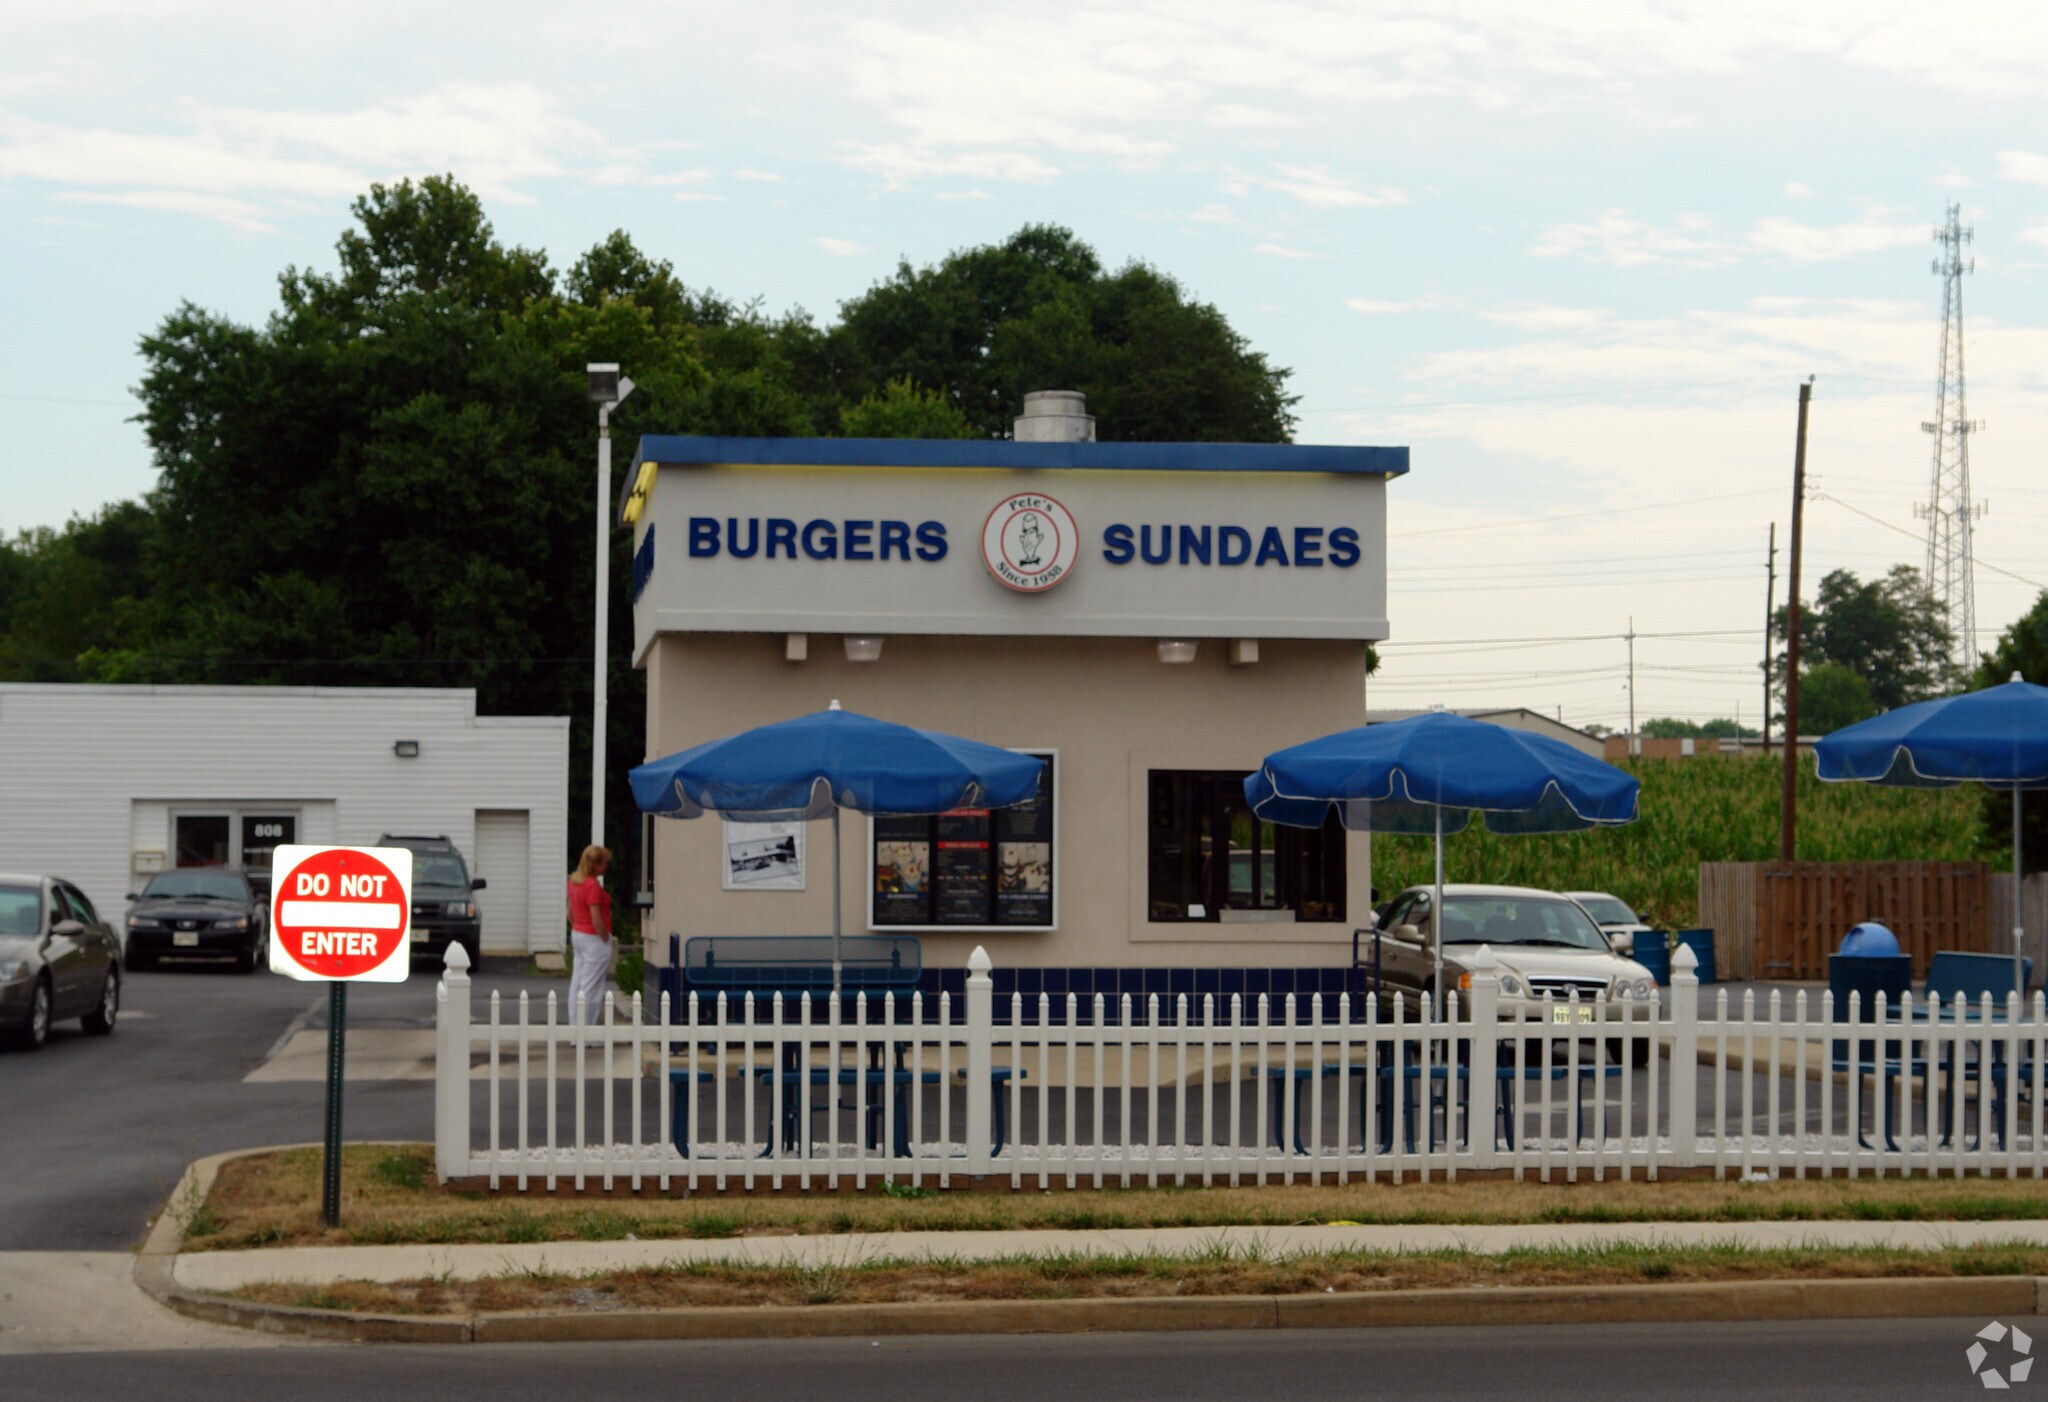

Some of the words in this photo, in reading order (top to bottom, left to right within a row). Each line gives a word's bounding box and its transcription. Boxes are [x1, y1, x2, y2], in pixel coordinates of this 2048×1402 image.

[1009, 497, 1053, 512] Pete's
[689, 517, 949, 562] BURGERS
[1103, 524, 1361, 567] SUNDAES
[997, 561, 1028, 586] Since
[1034, 565, 1062, 586] 1958
[254, 824, 283, 838] 808
[296, 873, 330, 897] DO
[340, 874, 387, 898] NOT
[302, 931, 378, 956] ENTER
